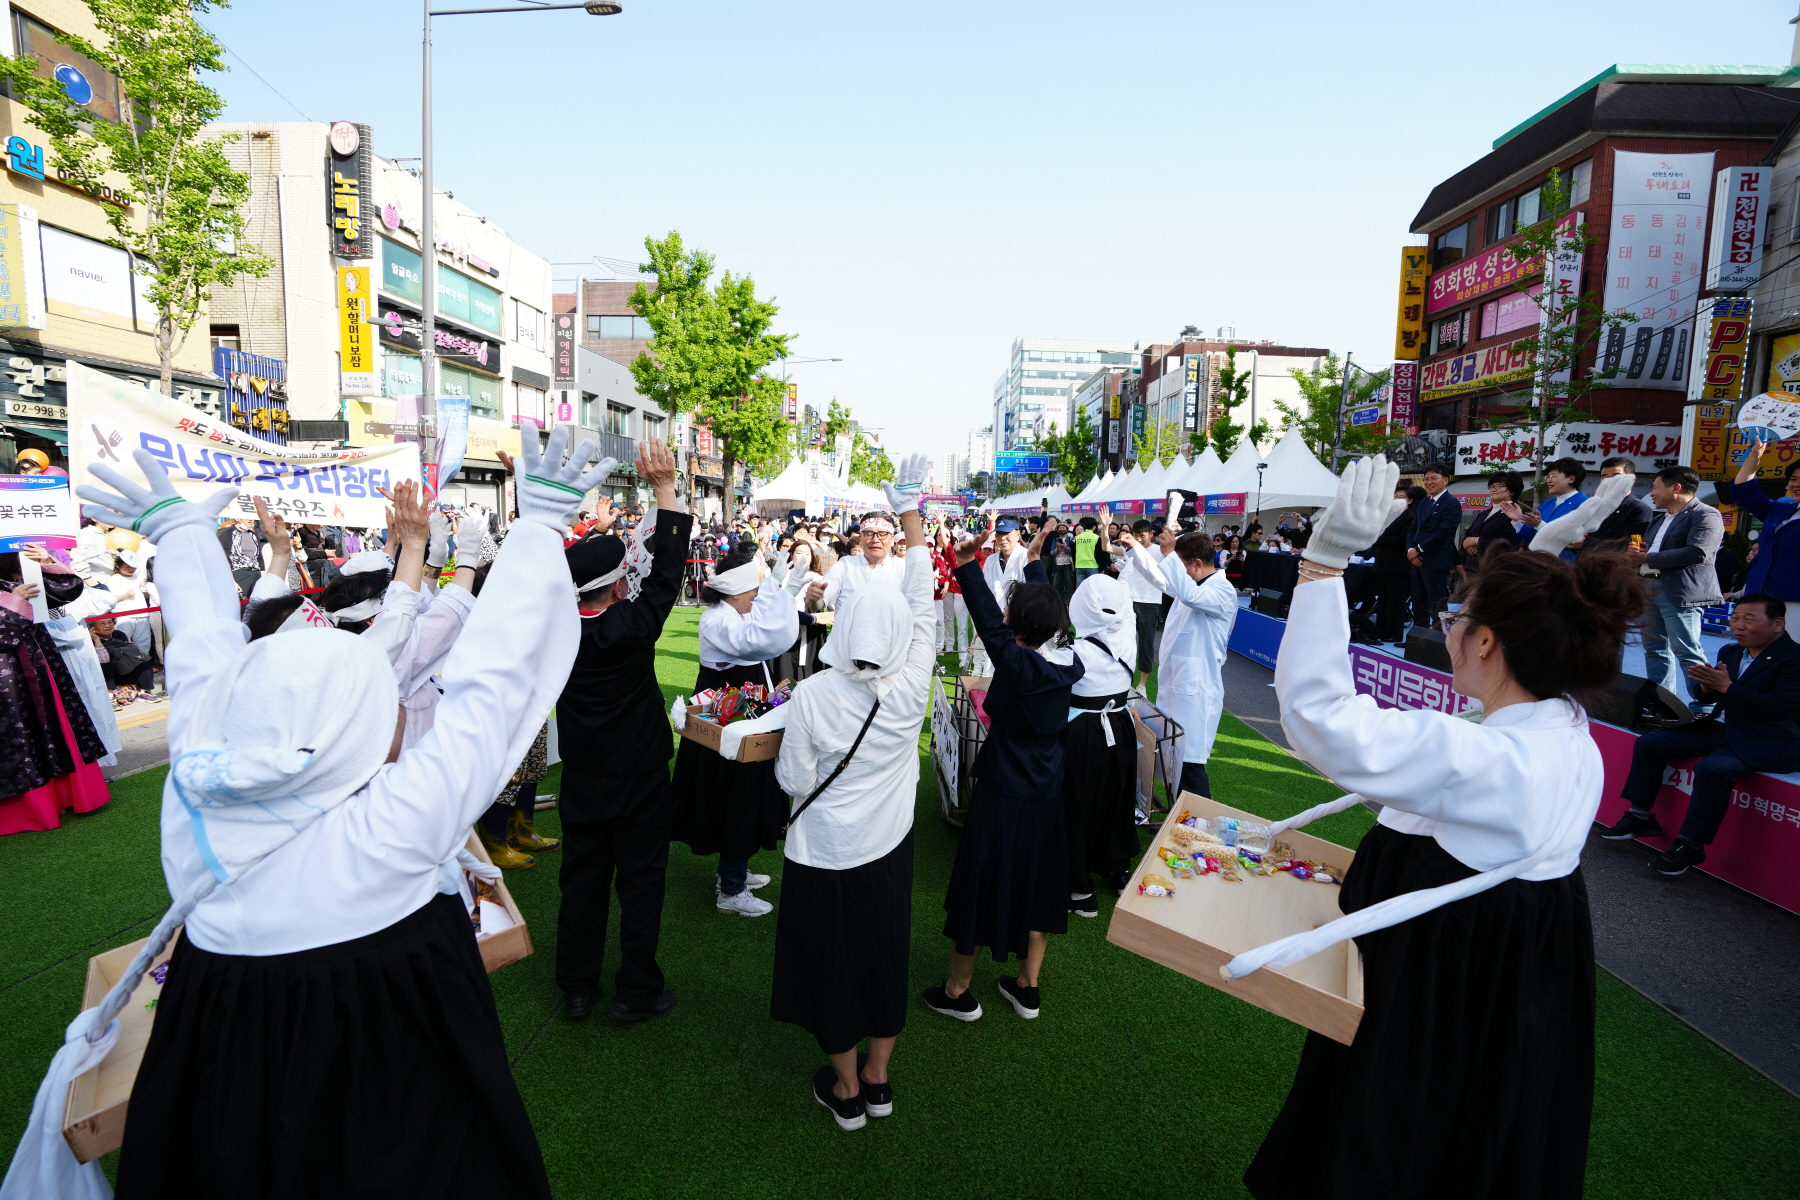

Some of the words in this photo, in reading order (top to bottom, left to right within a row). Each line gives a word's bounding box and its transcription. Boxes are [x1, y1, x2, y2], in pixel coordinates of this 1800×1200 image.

[1645, 178, 1691, 191] 동태요리
[1731, 197, 1759, 263] 천황궁
[1735, 266, 1745, 275] 3F
[1400, 281, 1422, 349] 노래방
[1706, 320, 1747, 385] PC
[1713, 388, 1729, 399] 2F
[13, 402, 67, 420] 02-998-8
[561, 405, 569, 420] NAIL
[1699, 406, 1725, 418] 대원
[1597, 431, 1682, 458] 동태요리
[1696, 419, 1722, 470] 부동산
[18, 505, 58, 519] 수유즈
[1077, 538, 1093, 547] STAFF
